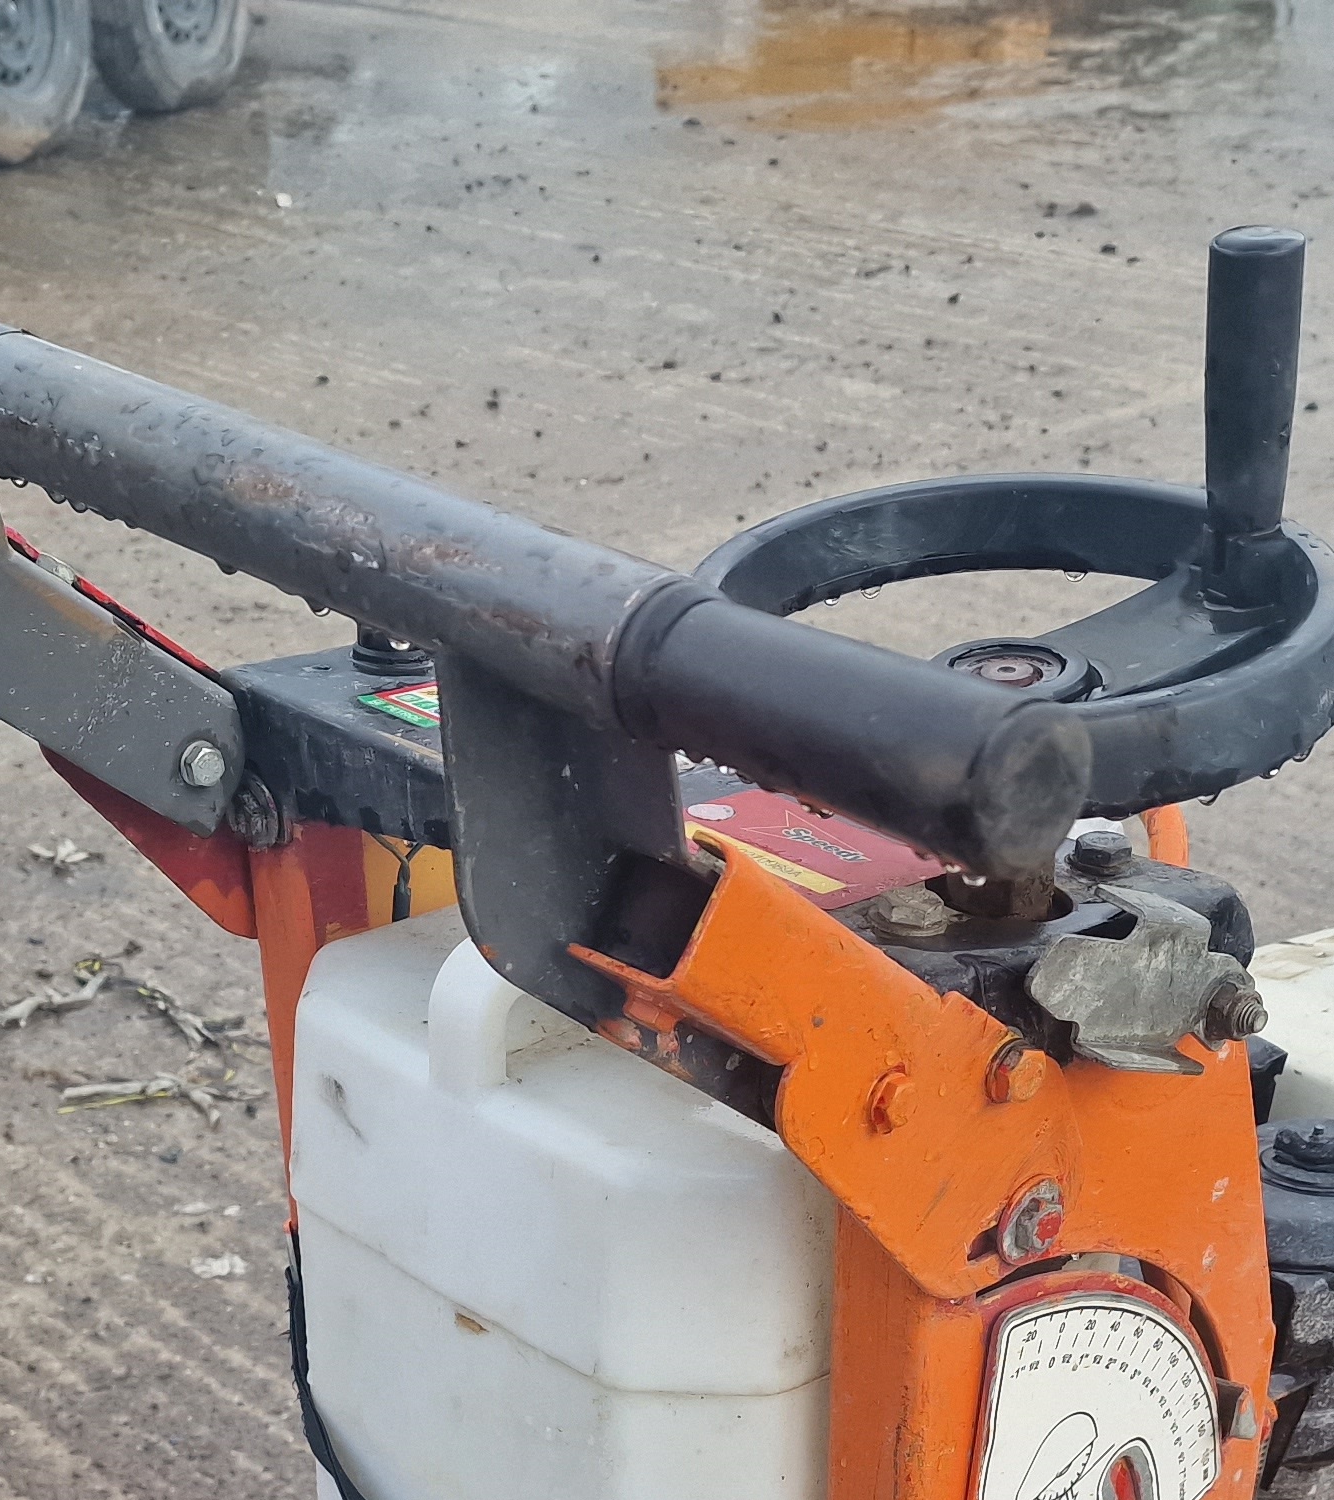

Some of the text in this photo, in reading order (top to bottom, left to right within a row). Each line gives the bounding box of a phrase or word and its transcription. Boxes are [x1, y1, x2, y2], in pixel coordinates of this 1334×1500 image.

[782, 827, 867, 862] Speedy
[1022, 1329, 1037, 1343] -20
[1059, 1322, 1065, 1333] 0
[1084, 1319, 1096, 1330] 20
[1110, 1321, 1120, 1332] 40
[1167, 1352, 1179, 1368] 100
[1181, 1372, 1191, 1388] 120
